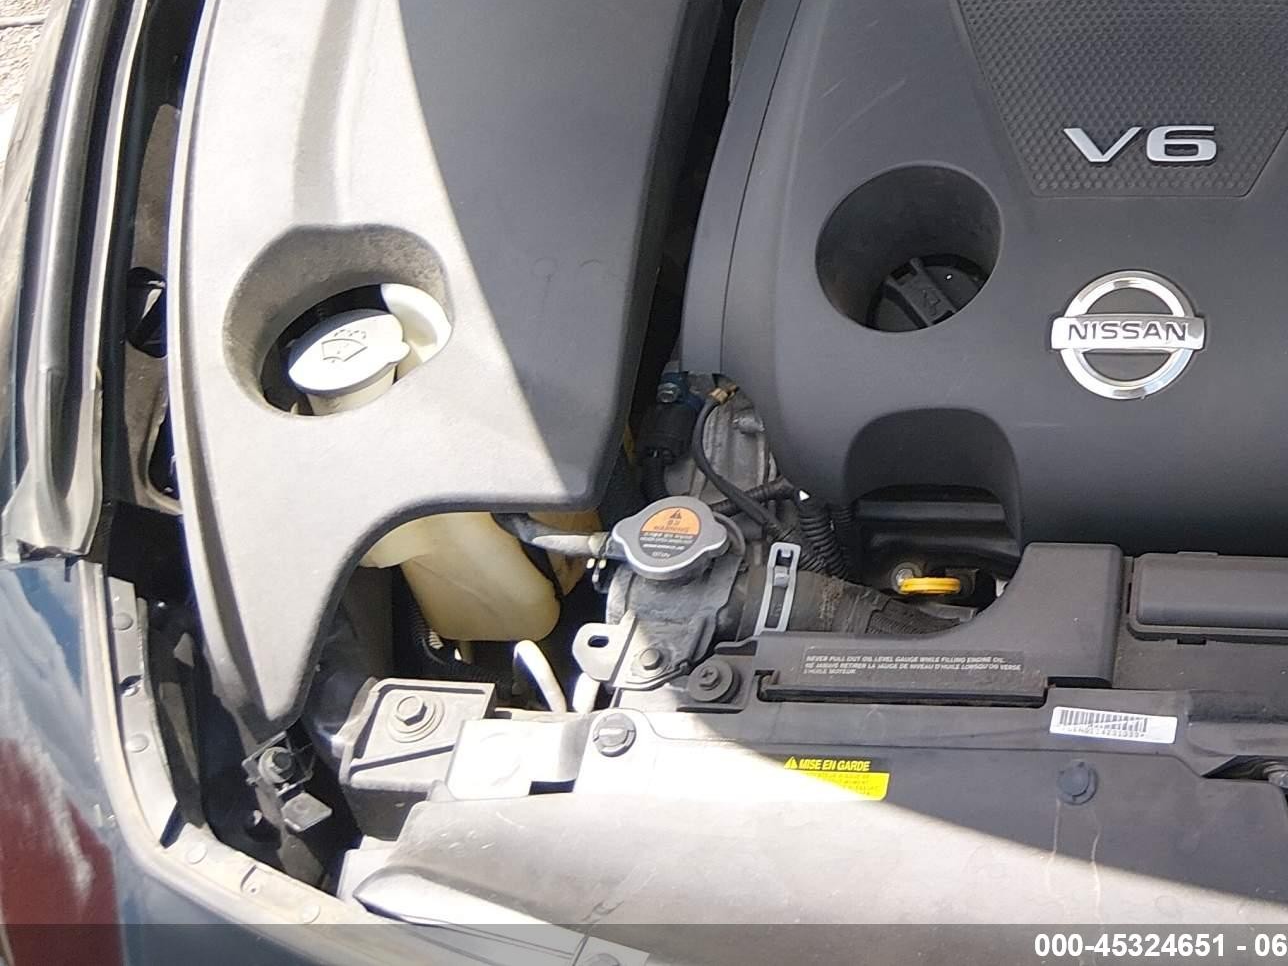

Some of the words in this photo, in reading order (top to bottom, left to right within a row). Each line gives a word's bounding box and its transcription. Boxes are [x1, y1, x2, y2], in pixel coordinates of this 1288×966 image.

[1063, 125, 1217, 163] V6
[1067, 320, 1189, 341] NISSAN
[799, 758, 823, 770] MISE
[822, 759, 835, 770] EN
[837, 760, 871, 772] GARDE
